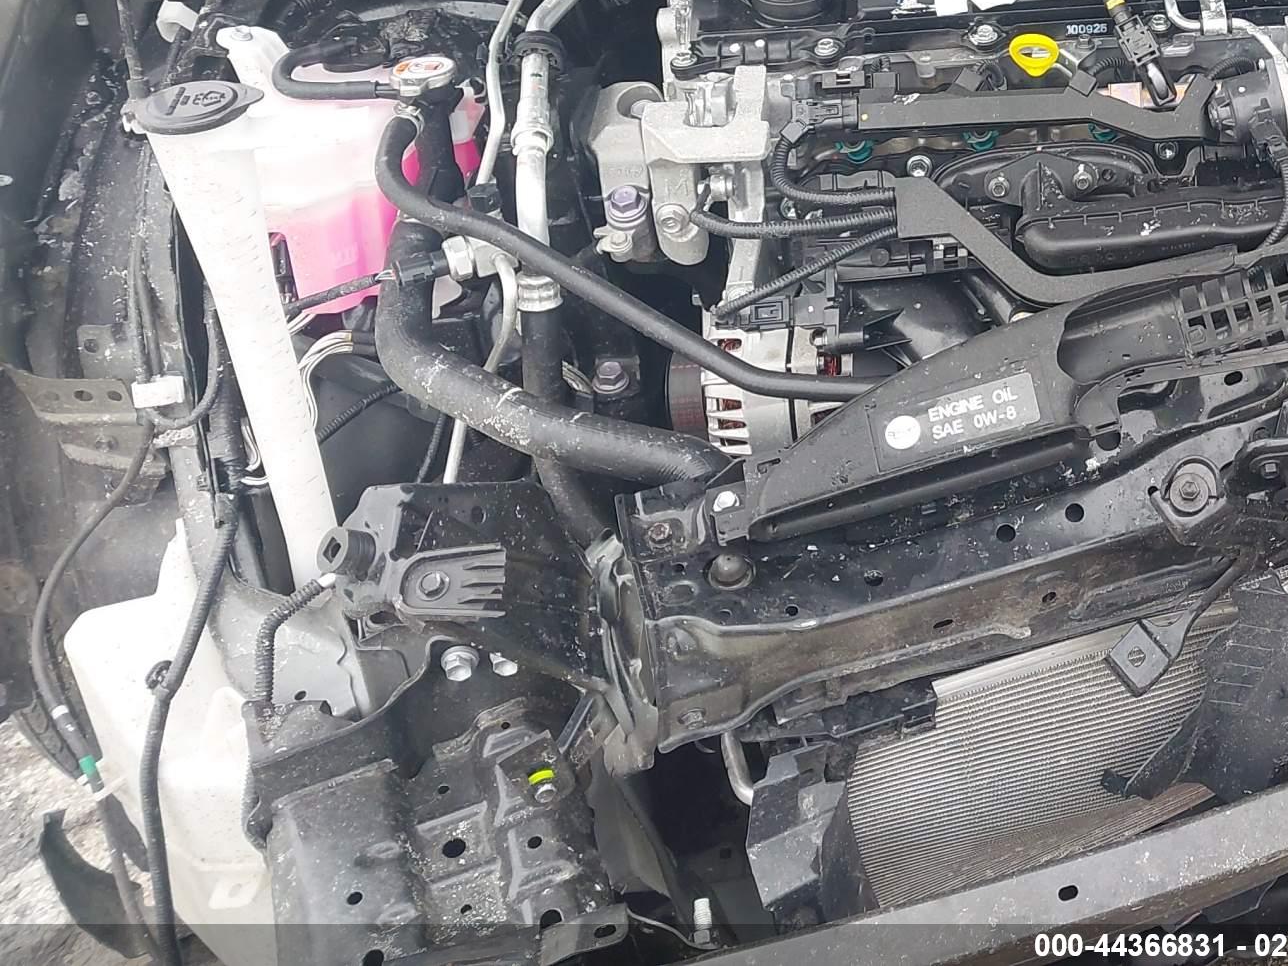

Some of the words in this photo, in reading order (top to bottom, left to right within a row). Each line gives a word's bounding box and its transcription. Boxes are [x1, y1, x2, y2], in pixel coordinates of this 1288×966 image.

[927, 394, 984, 422] ENGINE
[992, 386, 1018, 404] OIL
[932, 419, 964, 440] SAE
[973, 405, 1017, 429] 0W-8
